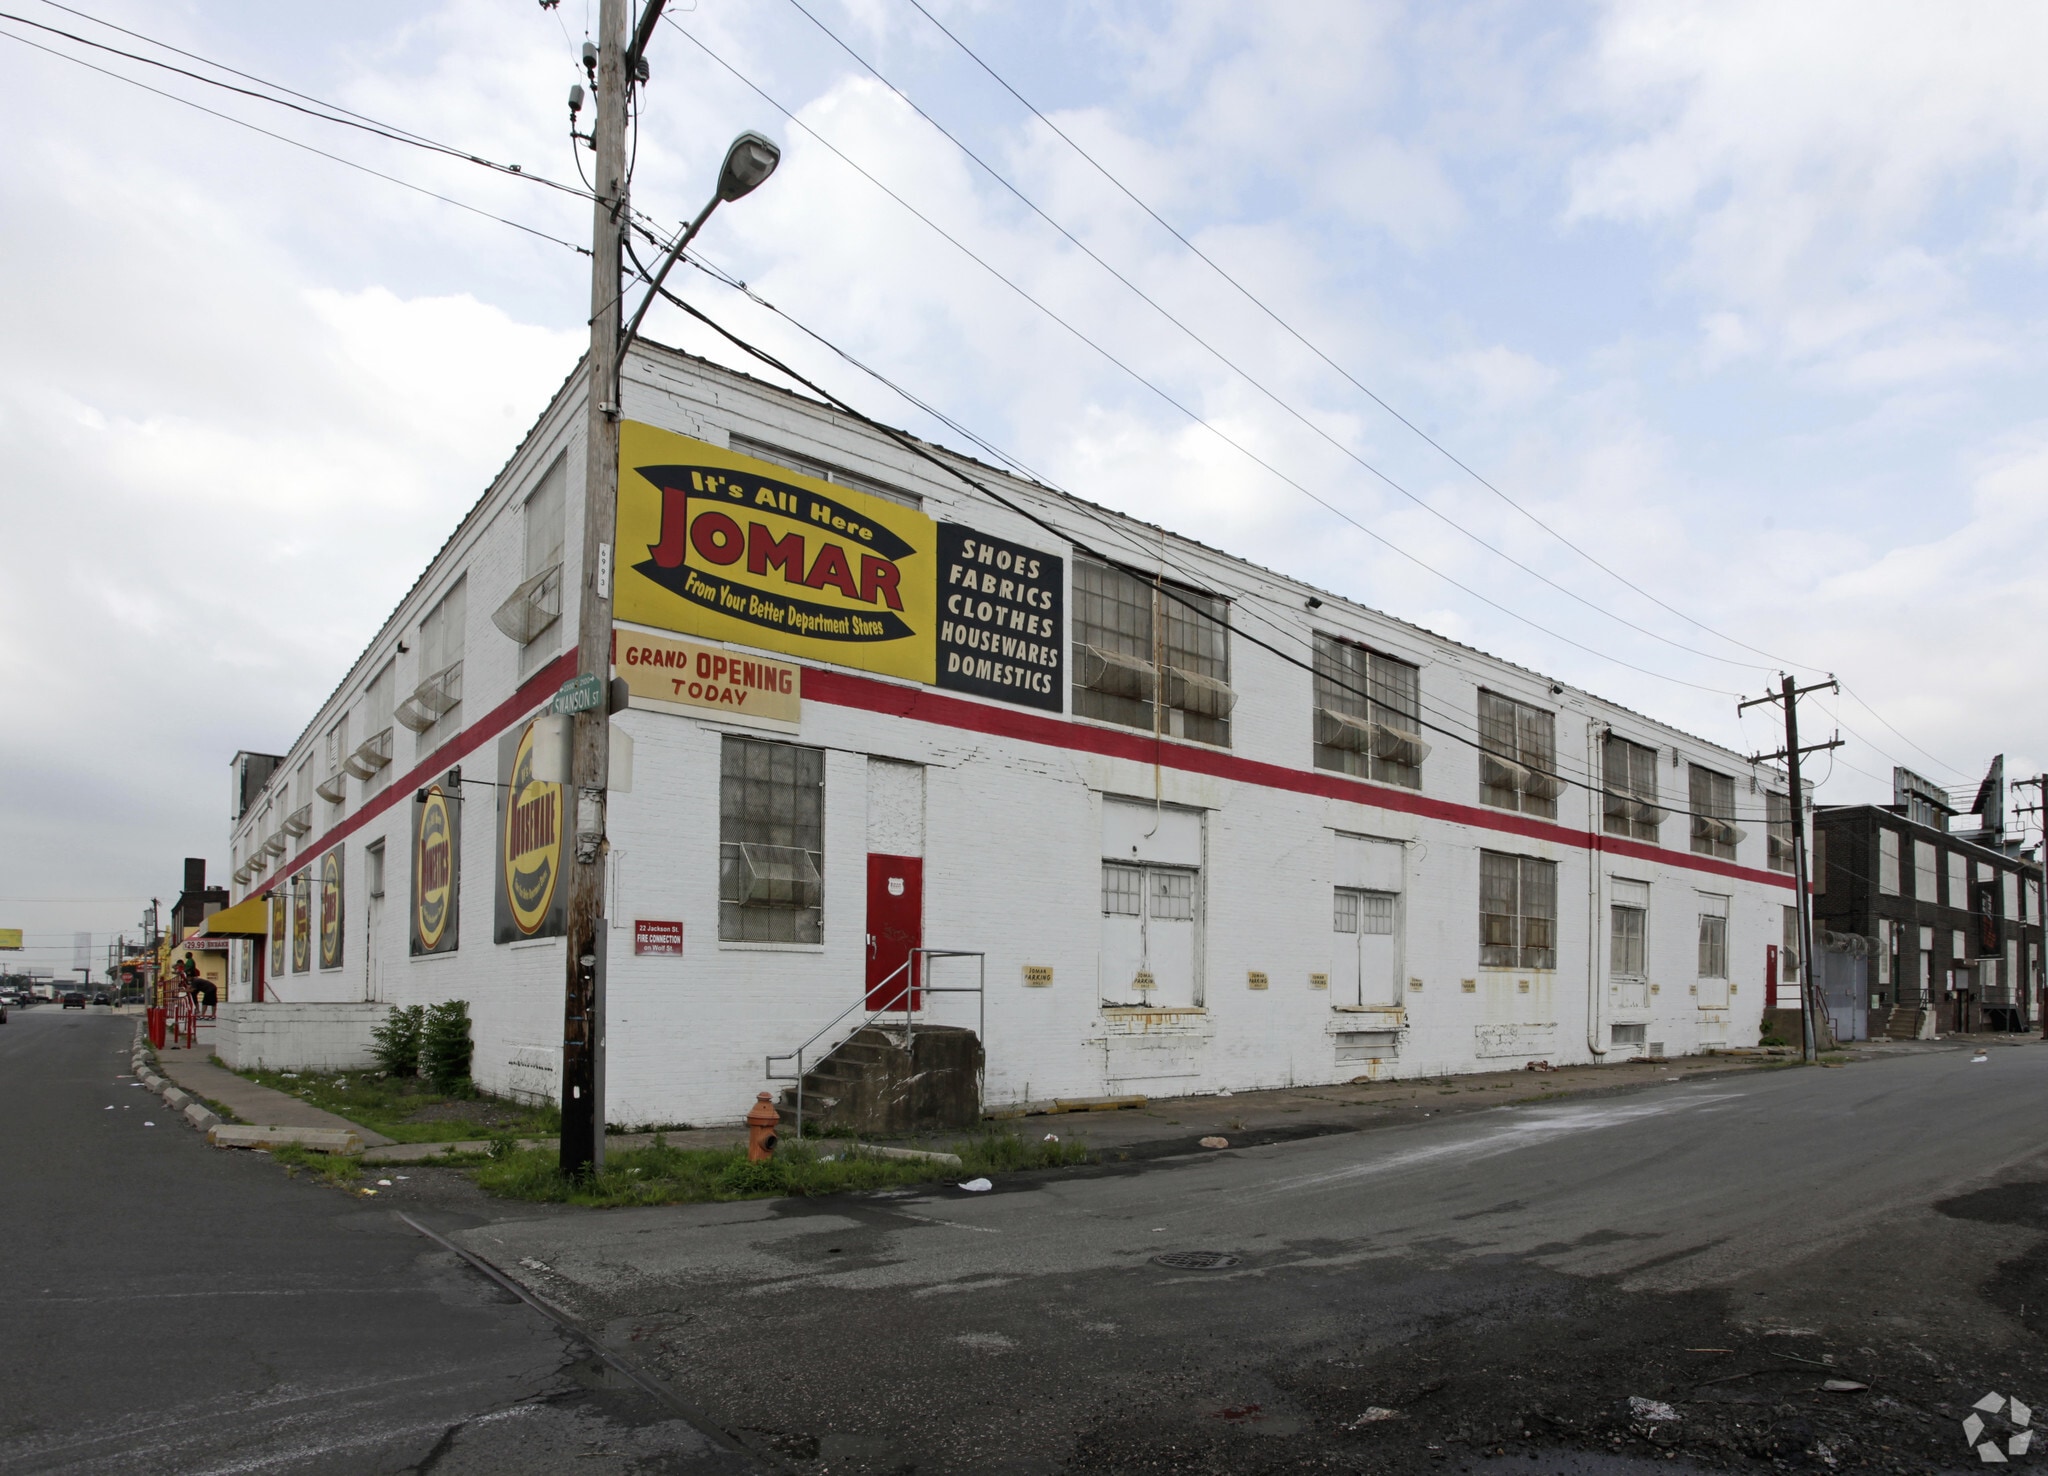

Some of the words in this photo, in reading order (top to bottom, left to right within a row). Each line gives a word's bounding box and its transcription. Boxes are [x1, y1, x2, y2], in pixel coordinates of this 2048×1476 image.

[691, 471, 744, 498] It's
[755, 487, 797, 513] All
[810, 503, 873, 540] Here
[646, 486, 905, 612] JOMAR
[962, 539, 1040, 579] SHOES
[685, 572, 716, 602] From
[720, 585, 746, 612] Your
[749, 595, 784, 623] Better
[788, 605, 849, 636] Department
[852, 616, 883, 635] Stores
[949, 564, 1052, 610] FABRICS
[947, 594, 1053, 637] CLOTHES
[941, 620, 1058, 667] HOUSEWARES
[626, 646, 687, 669] GRAND
[696, 652, 792, 695] OPENING
[671, 678, 748, 706] TODAY
[947, 652, 1051, 694] DOMESTICS
[555, 688, 590, 713] SWANSON
[592, 691, 599, 705] ST
[637, 934, 648, 942] FIRE
[649, 935, 681, 943] CONNECTION
